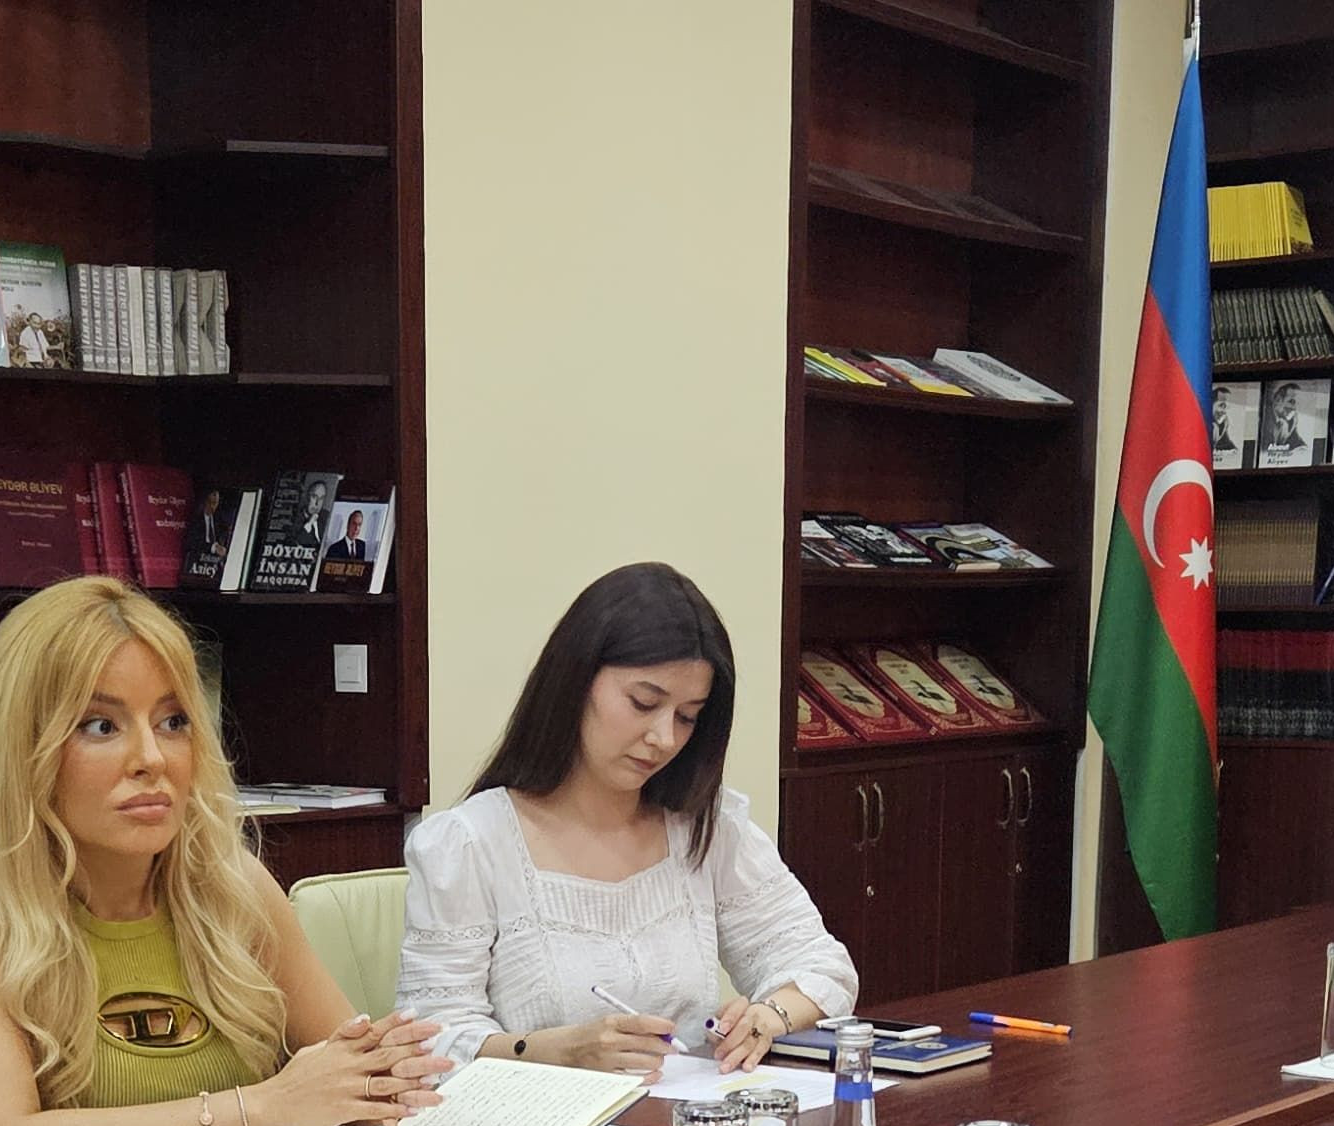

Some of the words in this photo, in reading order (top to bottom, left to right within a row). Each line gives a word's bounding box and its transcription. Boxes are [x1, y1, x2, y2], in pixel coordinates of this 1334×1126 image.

[29, 481, 63, 494] ƏLİYEV
[262, 543, 317, 560] BÖYÜK
[258, 560, 312, 576] İNSAN
[255, 575, 308, 586] HAQQINDA
